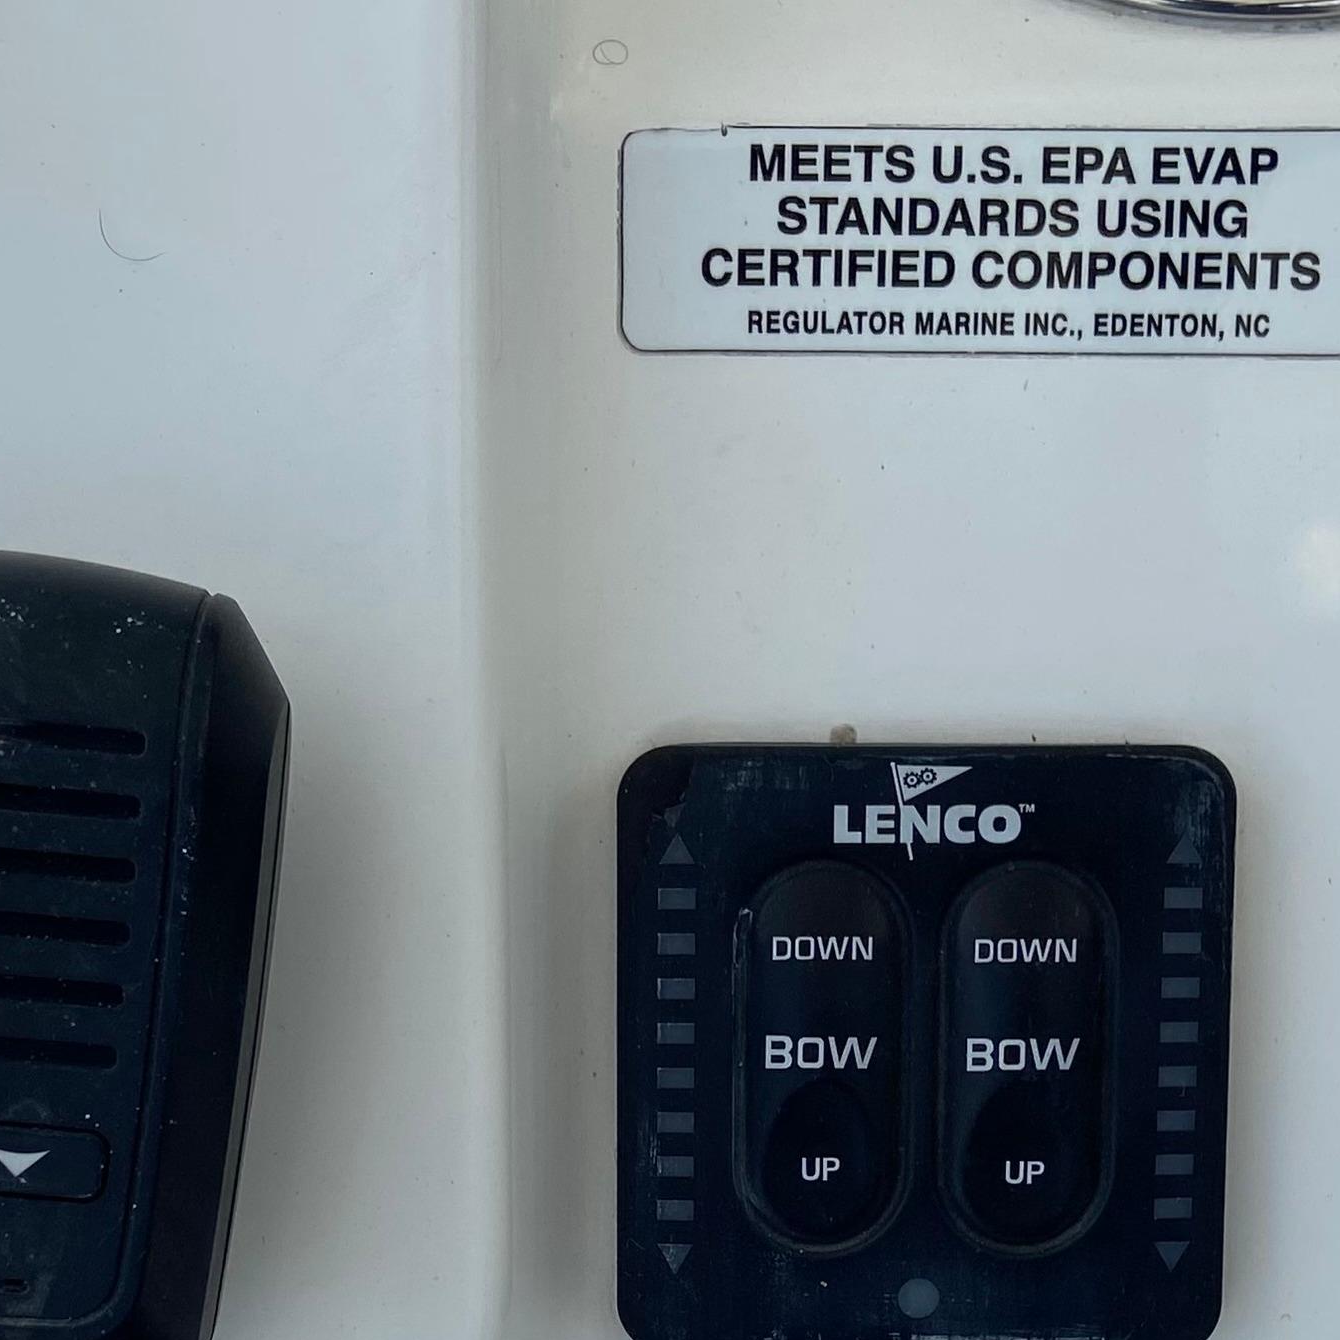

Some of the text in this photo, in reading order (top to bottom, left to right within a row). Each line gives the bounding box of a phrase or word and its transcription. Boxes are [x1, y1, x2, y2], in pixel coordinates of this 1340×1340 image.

[749, 143, 1279, 185] MEETS U.S. EPA EVAP
[777, 195, 1248, 239] STANDARDS USING
[701, 247, 1321, 291] CERTIFIED COMPONENTS
[747, 310, 1270, 342] REGULATOR MARINE INC., EDENTON, NC
[833, 804, 1022, 845] LENCO
[772, 936, 873, 961] DOWN
[974, 938, 1077, 964] DOWN
[765, 1034, 878, 1070] BOW
[966, 1037, 1081, 1072] BOW
[801, 1157, 840, 1181] UP
[1005, 1160, 1045, 1185] UP
